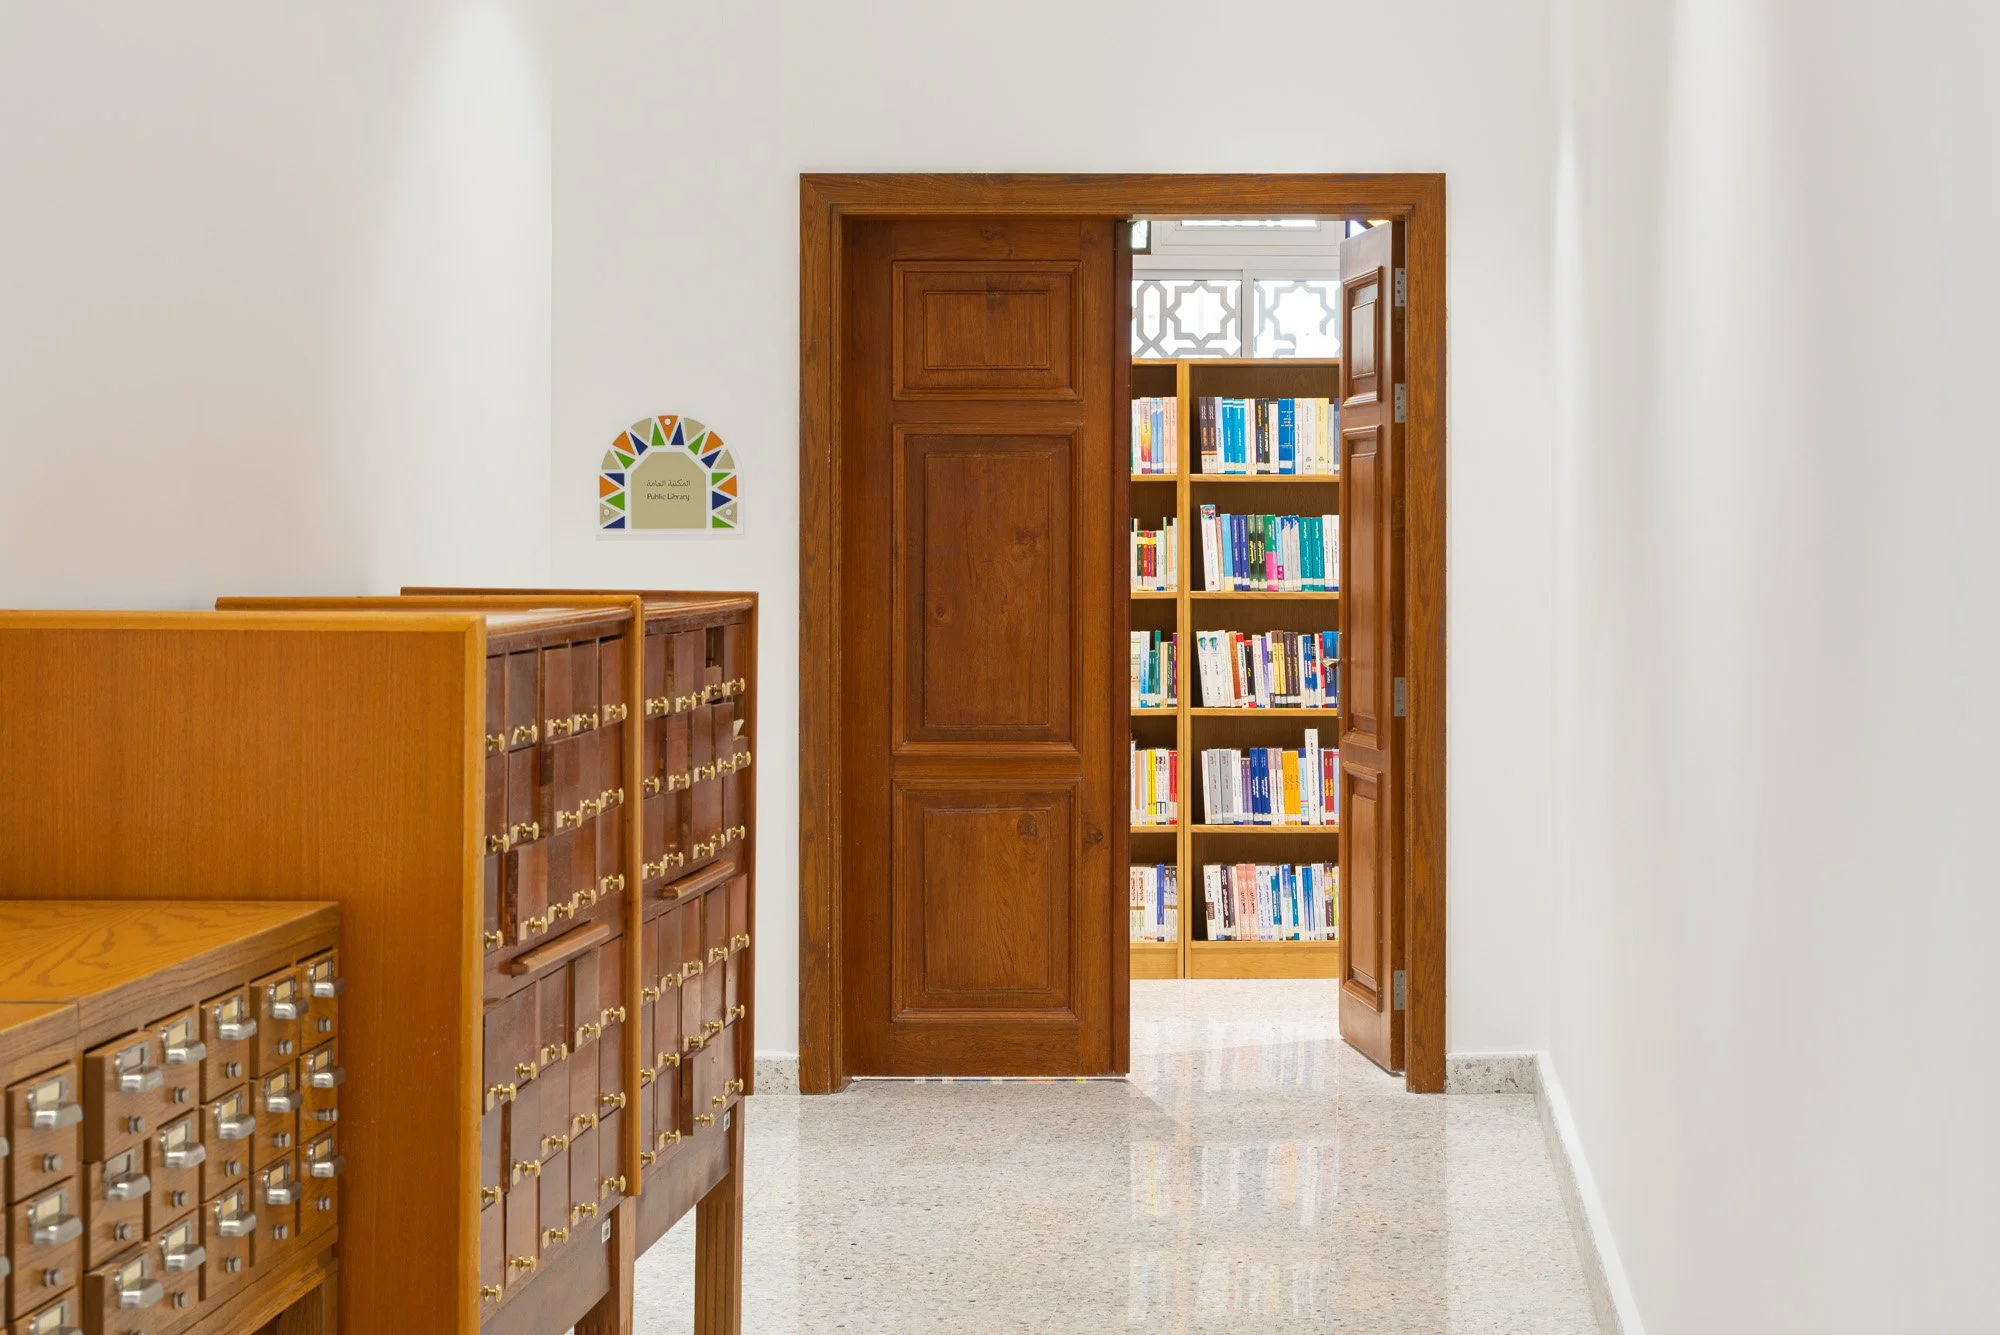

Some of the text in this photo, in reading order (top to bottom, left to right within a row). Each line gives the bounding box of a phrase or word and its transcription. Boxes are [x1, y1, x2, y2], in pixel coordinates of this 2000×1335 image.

[646, 478, 690, 488] المكتبة العامة
[667, 493, 690, 501] Library
